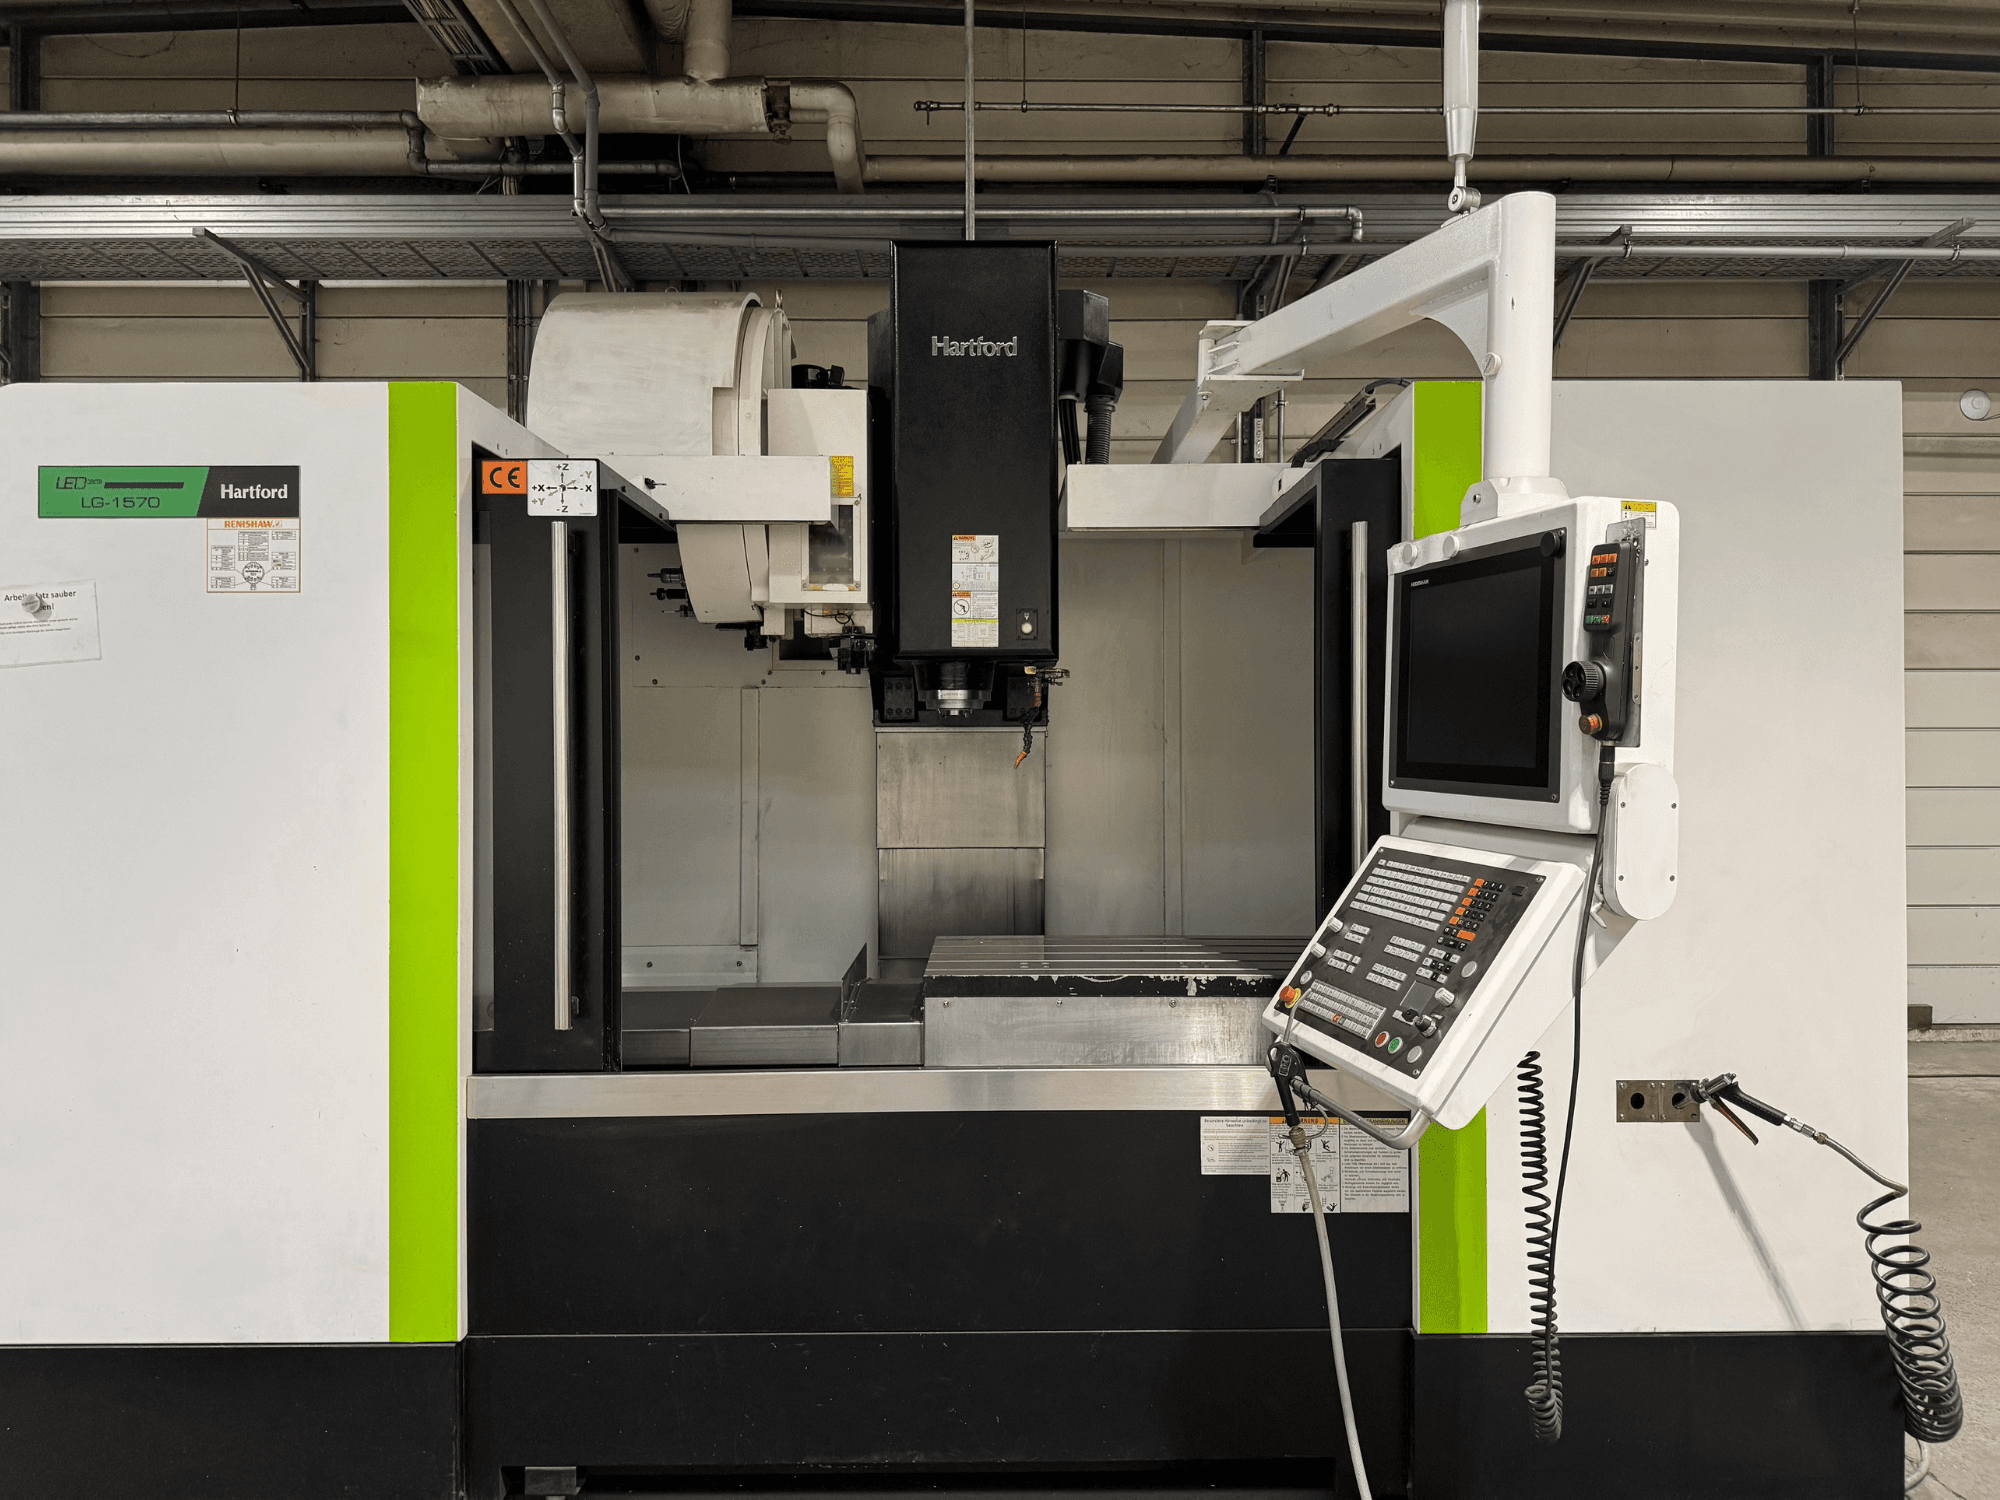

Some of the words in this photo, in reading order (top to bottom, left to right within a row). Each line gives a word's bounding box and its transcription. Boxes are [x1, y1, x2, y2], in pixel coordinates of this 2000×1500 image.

[931, 335, 1018, 357] Hartford
[489, 466, 521, 488] CE
[220, 483, 288, 499] Hartford
[531, 484, 545, 492] +X
[81, 496, 160, 508] LG-1570
[224, 520, 273, 528] RENISHAW
[51, 590, 77, 598] sauber
